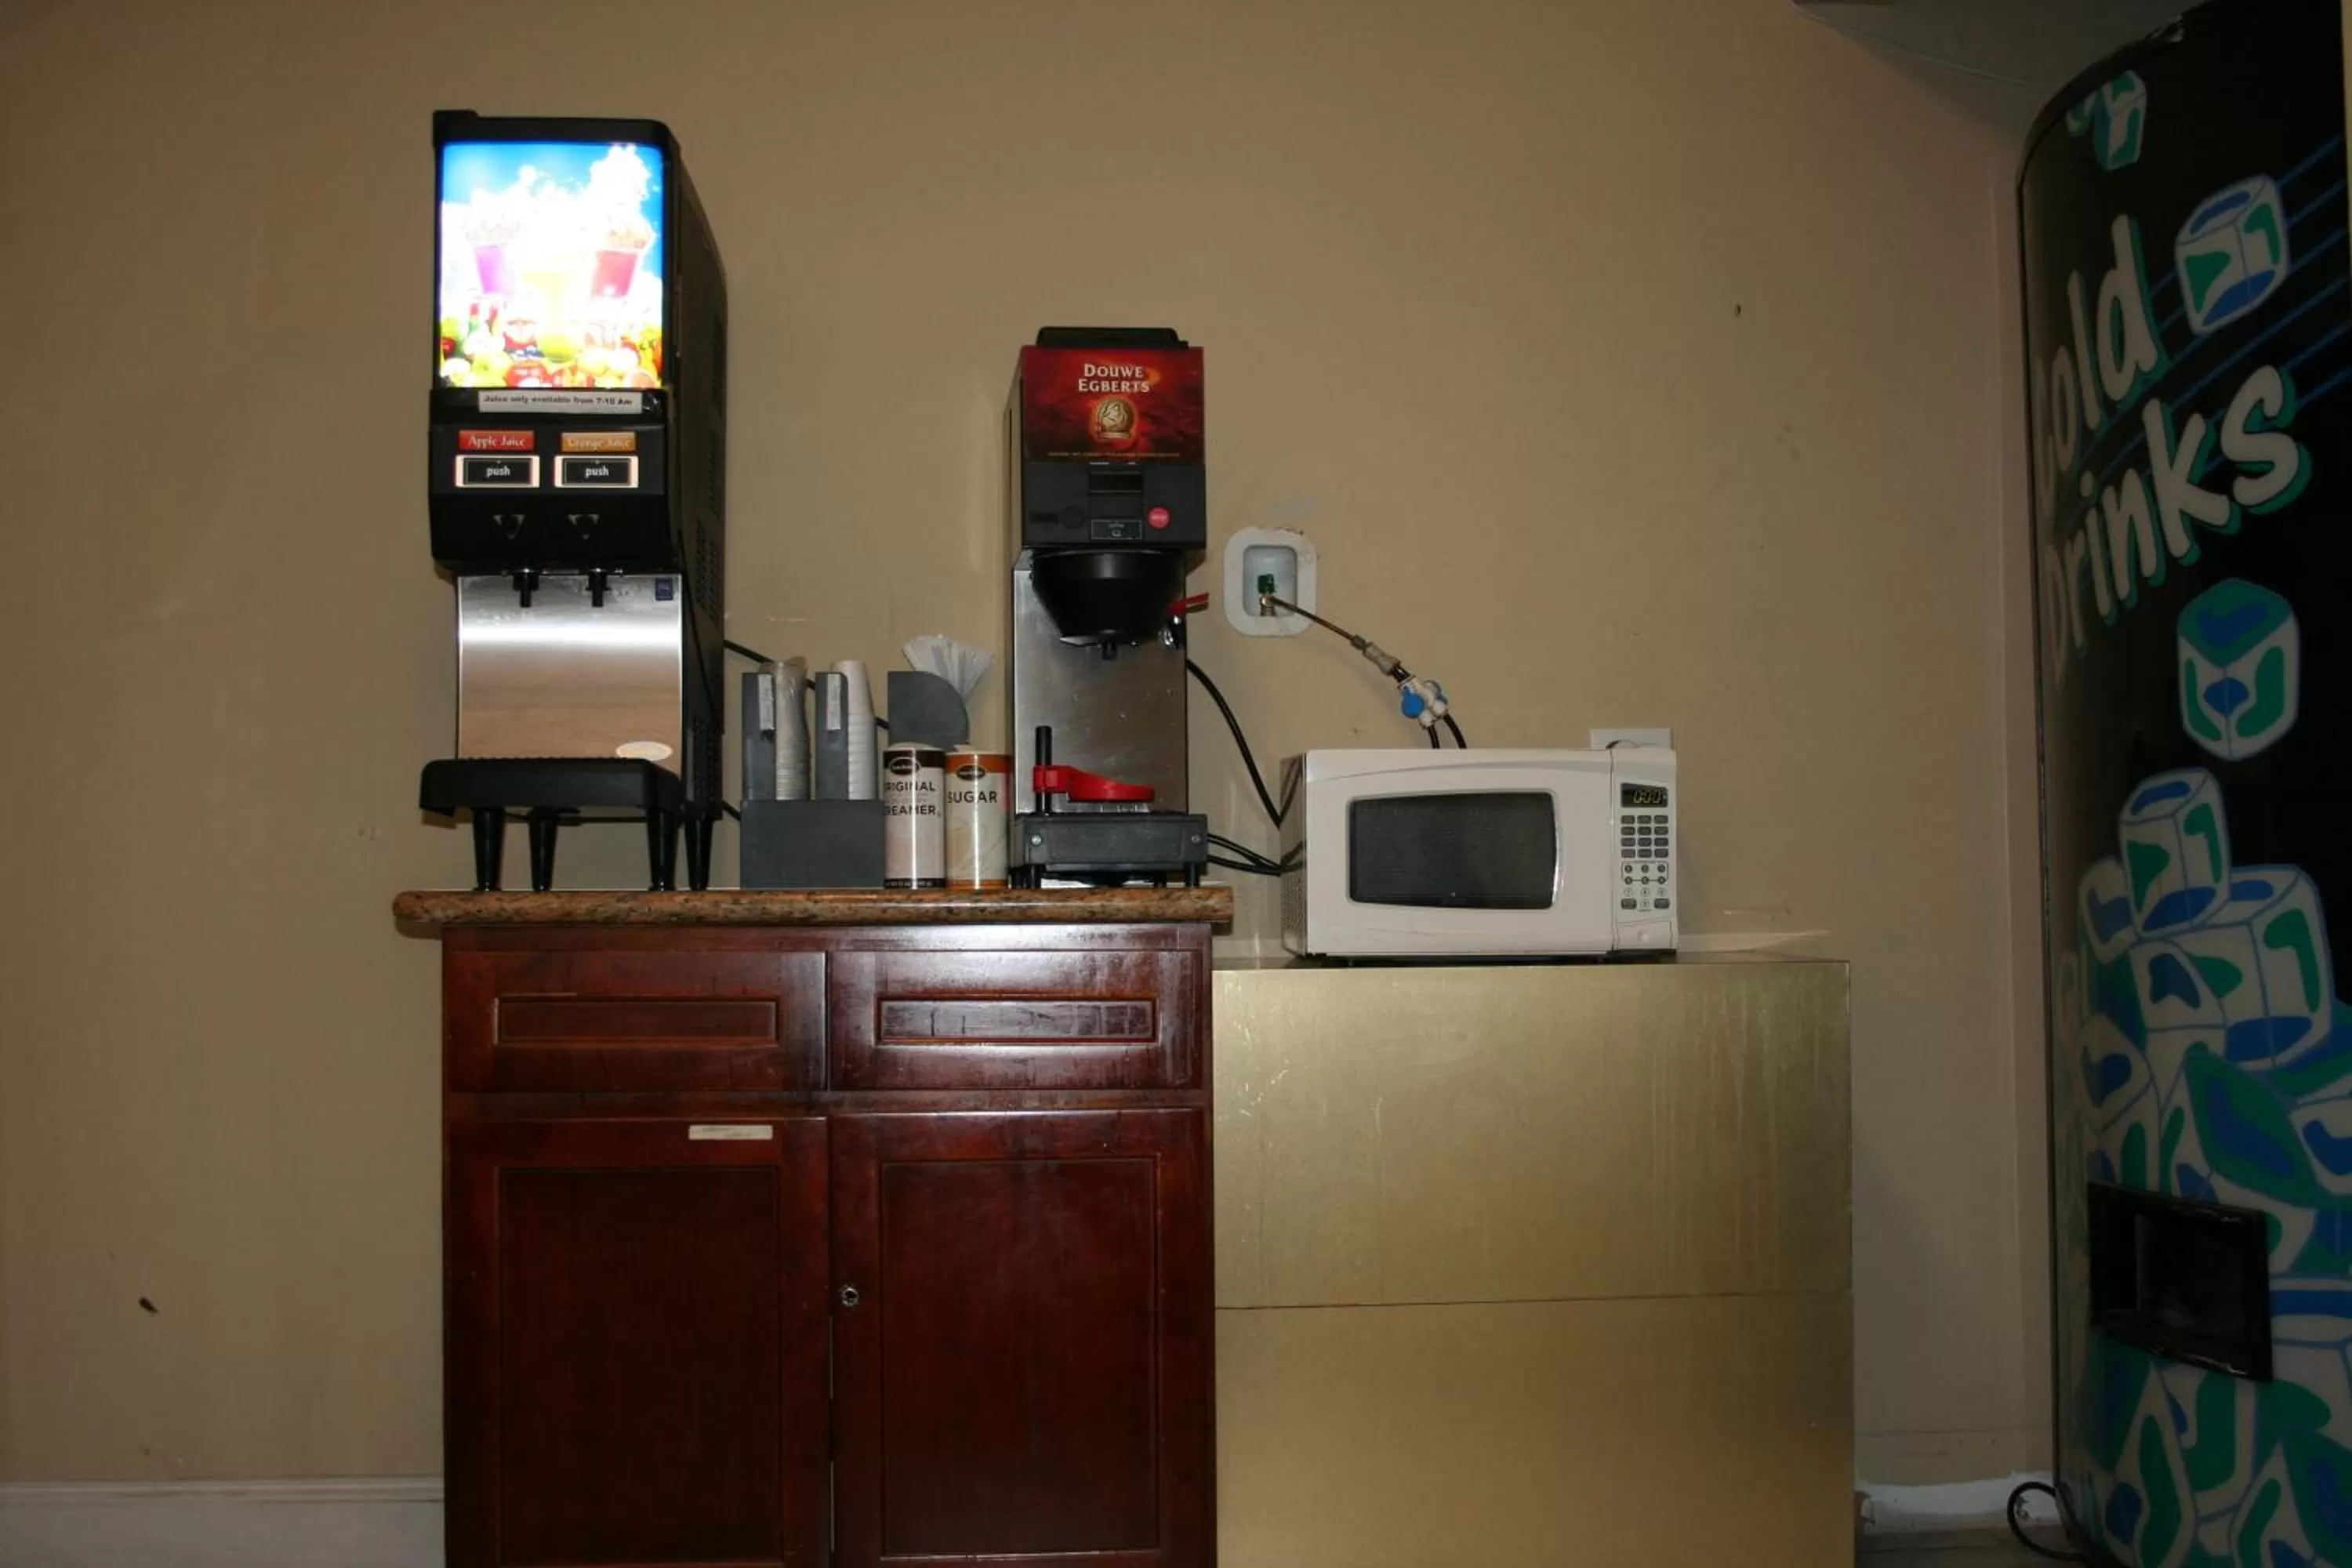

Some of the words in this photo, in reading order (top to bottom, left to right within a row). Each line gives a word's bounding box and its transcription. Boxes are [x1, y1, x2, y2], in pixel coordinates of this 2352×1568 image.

[1083, 363, 1144, 378] DOUWE
[1078, 379, 1150, 393] EGBERTS
[468, 435, 496, 449] Apple
[500, 435, 525, 448] Juice
[486, 465, 511, 478] push
[585, 465, 609, 478] push
[885, 781, 936, 792] RIGINAL
[948, 790, 998, 804] SUGAR
